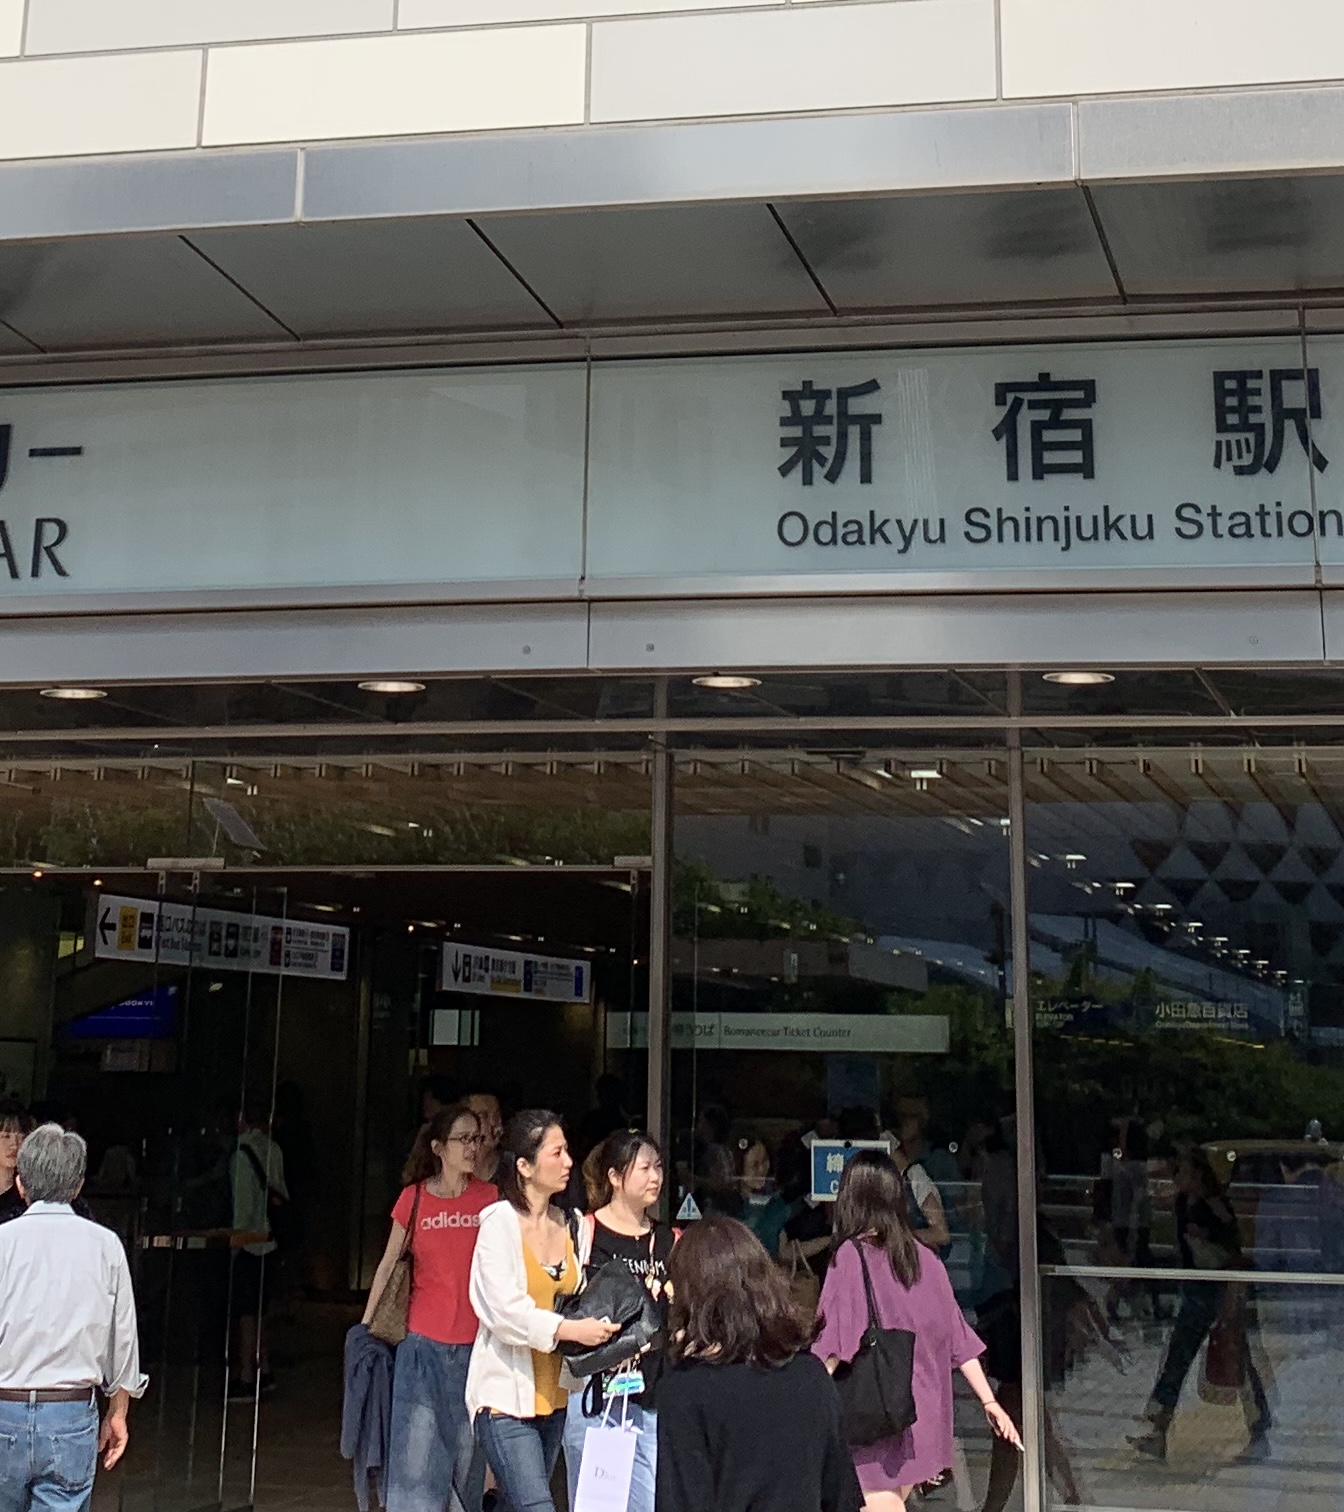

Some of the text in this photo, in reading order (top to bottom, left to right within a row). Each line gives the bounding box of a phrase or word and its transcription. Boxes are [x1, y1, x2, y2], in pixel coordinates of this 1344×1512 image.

[777, 510, 947, 555] Odakyu
[963, 504, 1156, 551] Shinjuku
[1174, 500, 1344, 541] Station
[420, 1210, 482, 1231] adidas
